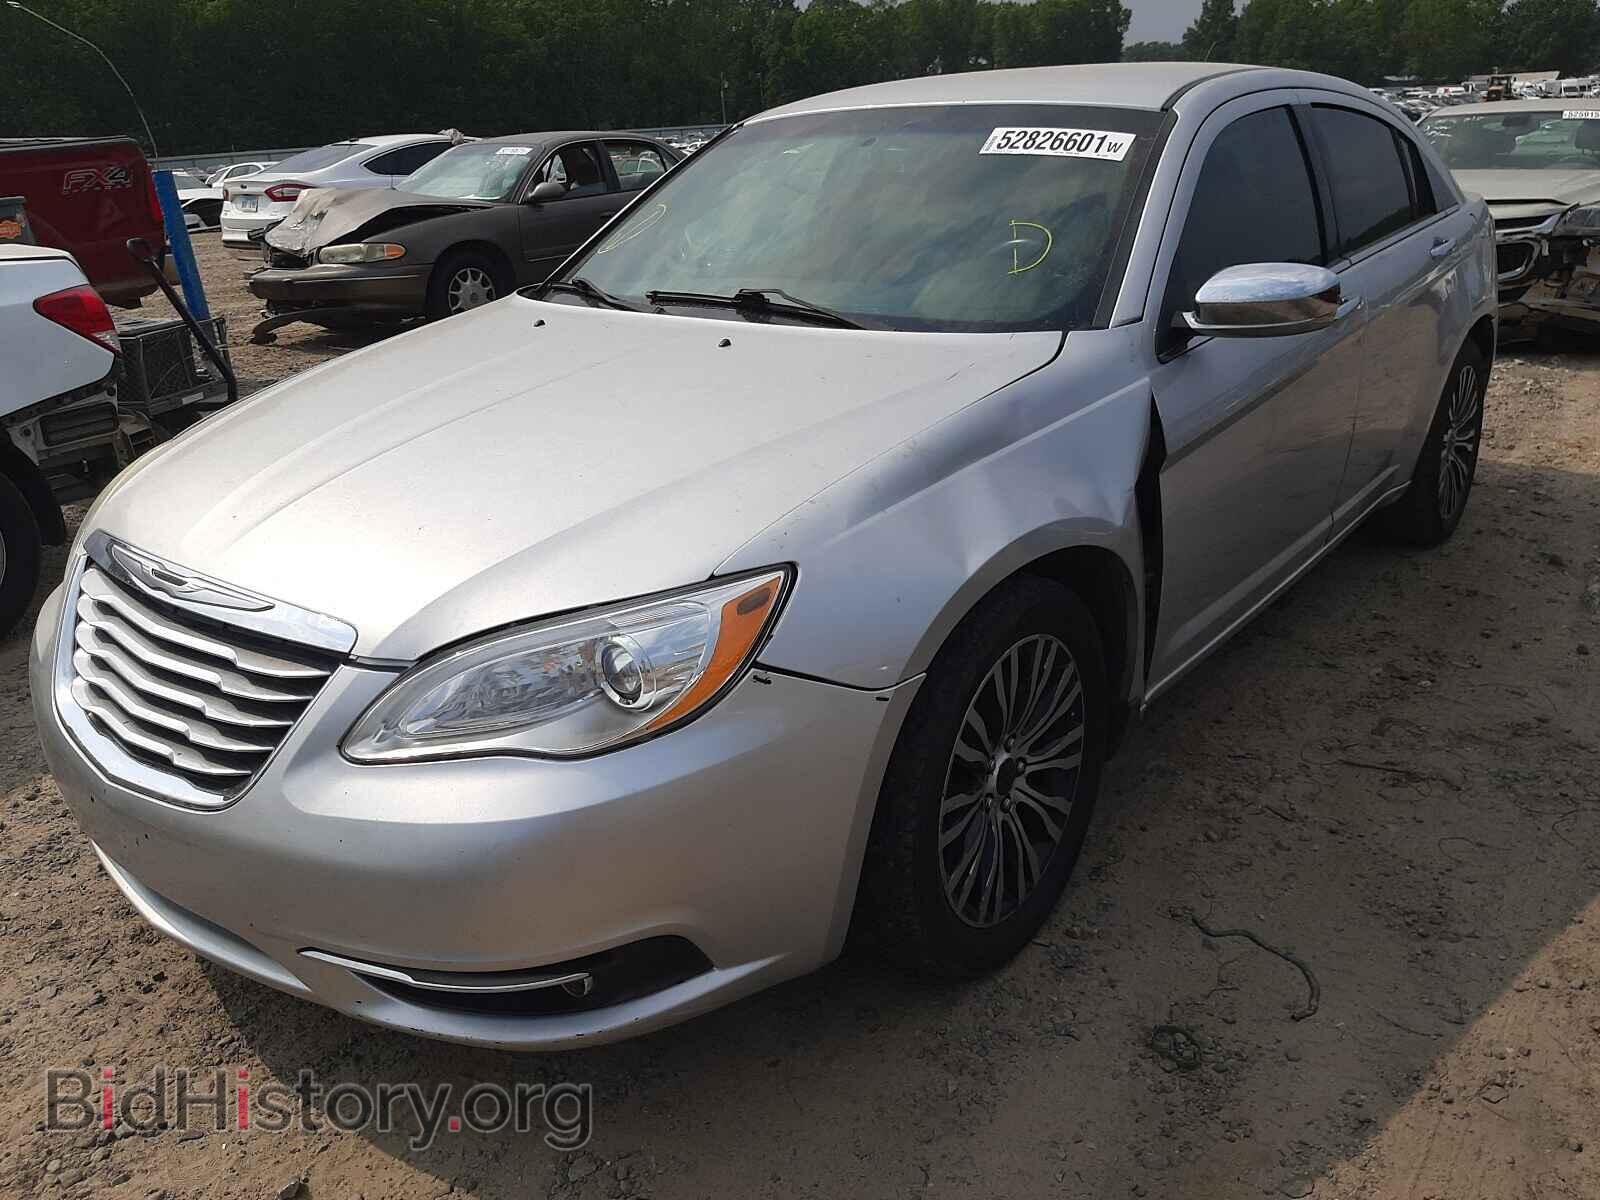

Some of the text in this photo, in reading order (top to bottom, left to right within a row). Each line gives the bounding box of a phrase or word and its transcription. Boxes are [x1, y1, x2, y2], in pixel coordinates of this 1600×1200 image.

[997, 131, 1109, 153] 52826601
[63, 167, 130, 190] FX4
[1008, 220, 1052, 274] D
